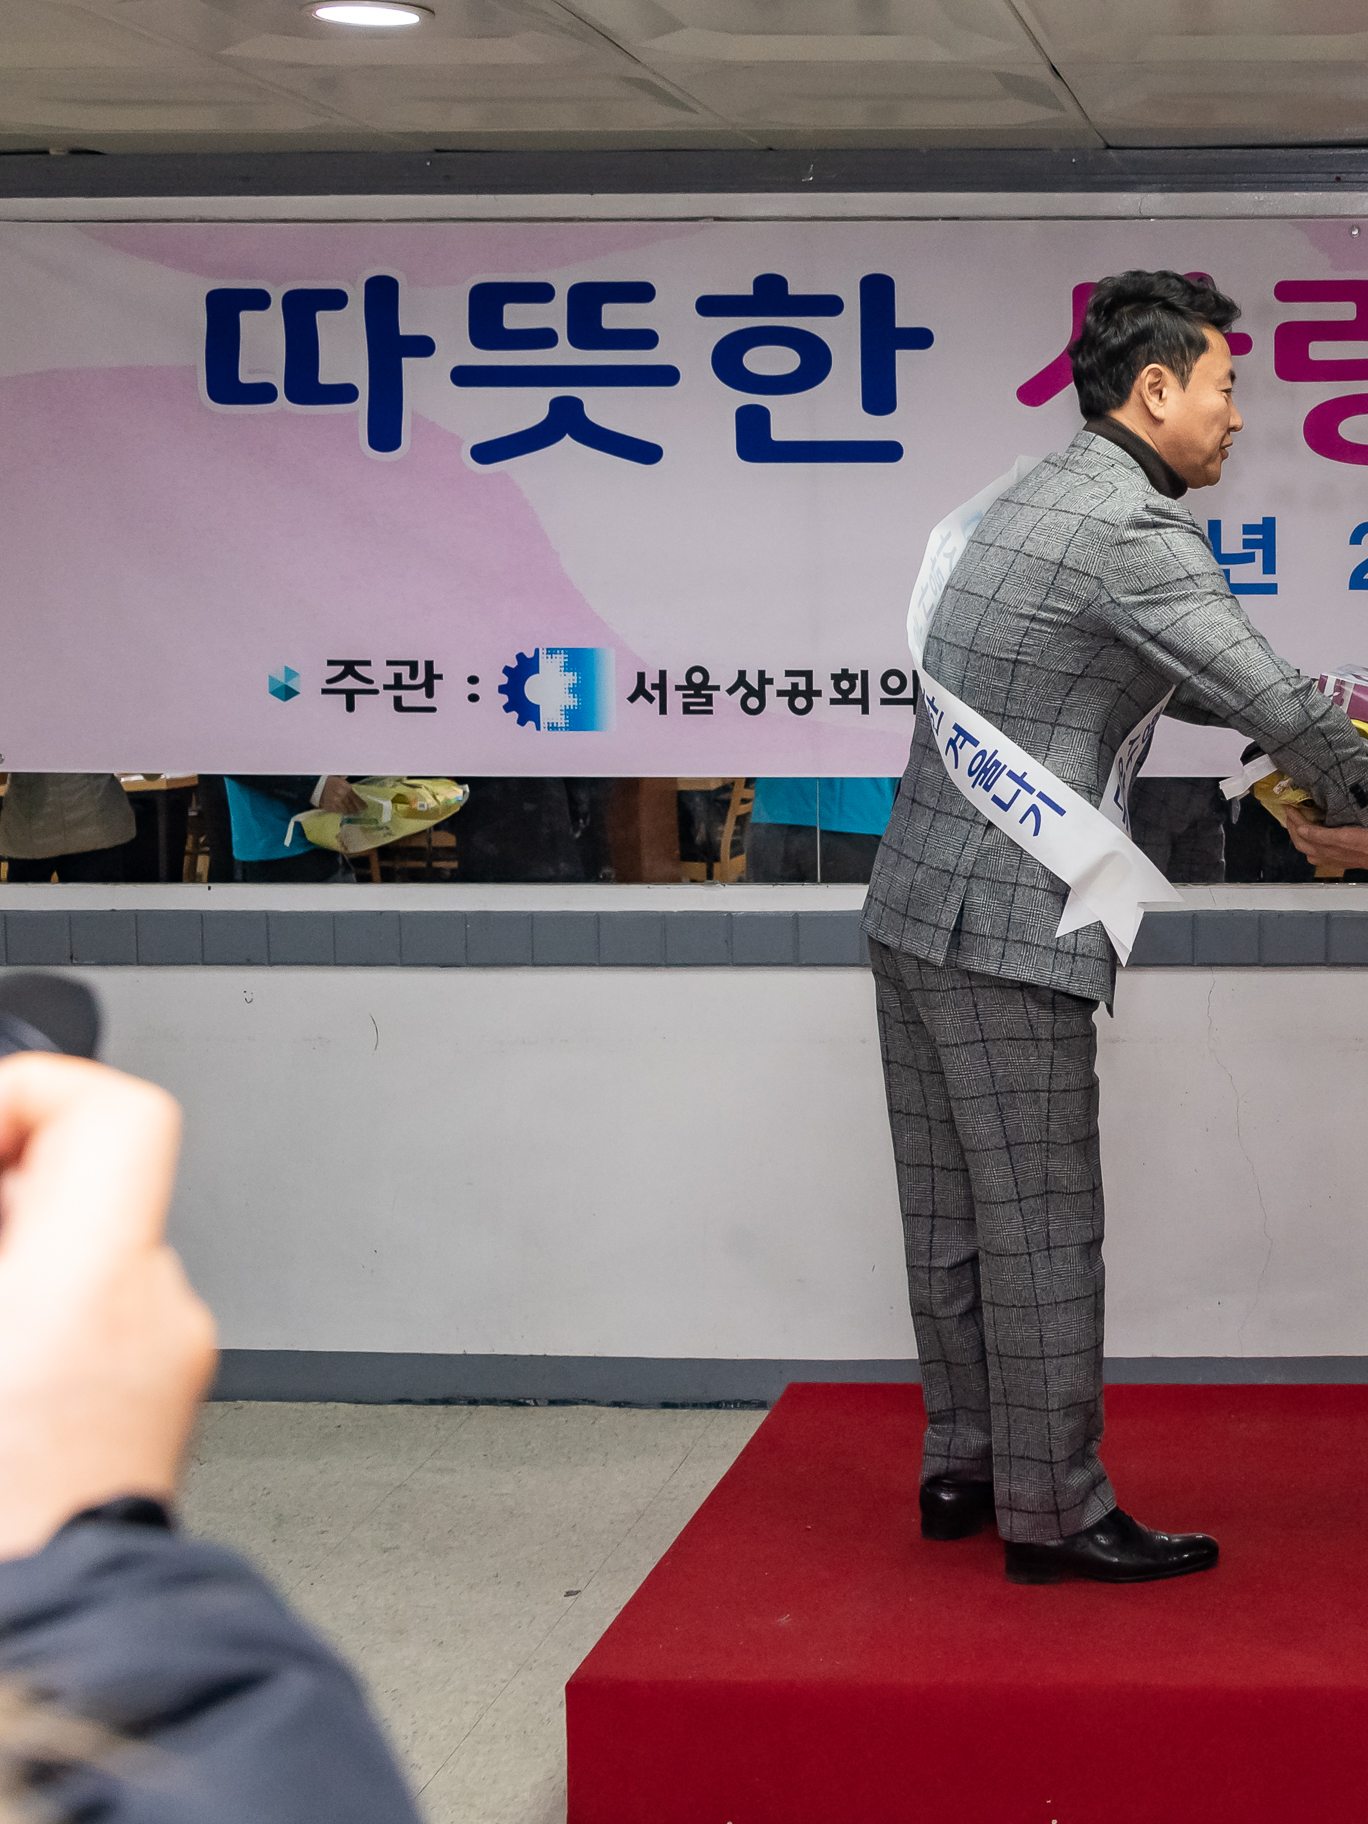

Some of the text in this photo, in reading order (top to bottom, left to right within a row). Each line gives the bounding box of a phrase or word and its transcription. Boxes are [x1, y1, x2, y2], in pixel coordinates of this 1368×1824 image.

[206, 273, 934, 465] 따뜻한
[321, 659, 443, 713] 주관
[627, 665, 919, 716] 서울상공회의
